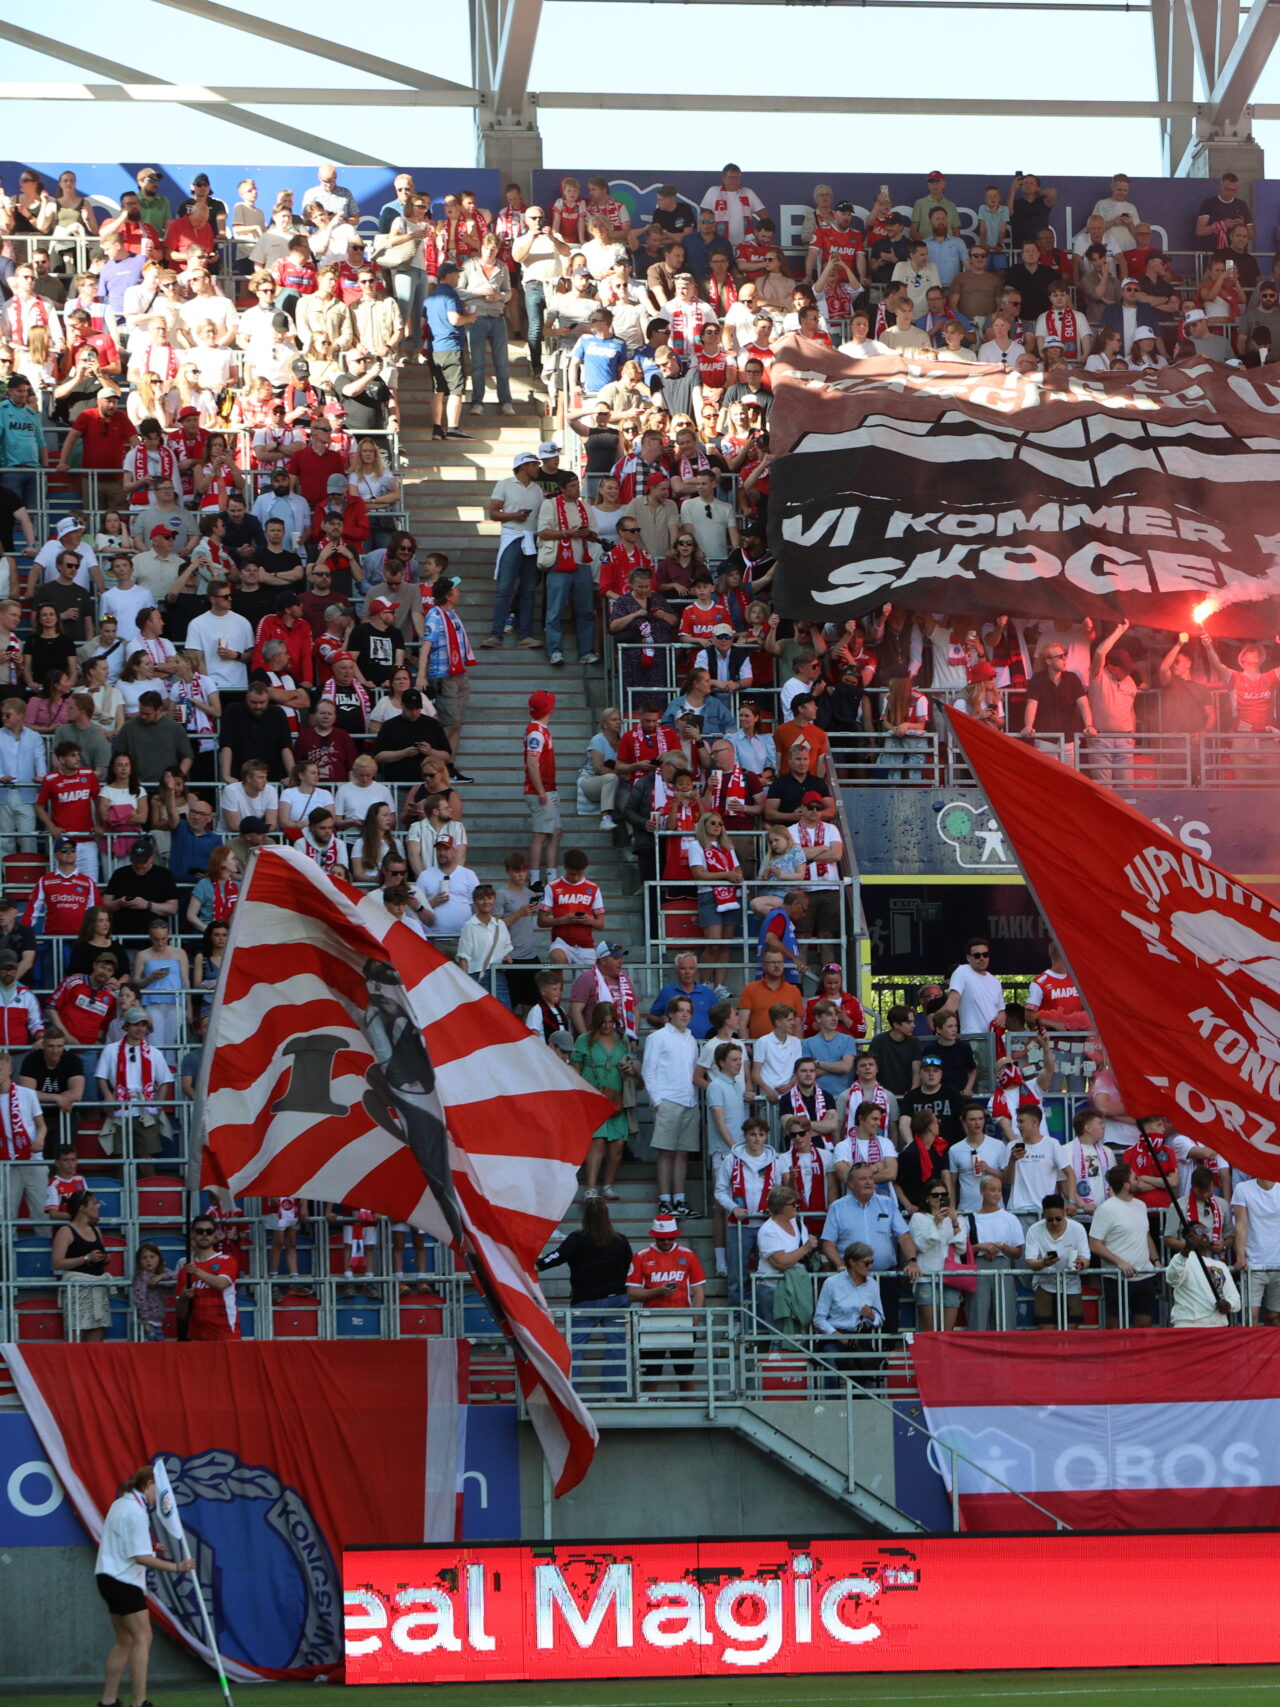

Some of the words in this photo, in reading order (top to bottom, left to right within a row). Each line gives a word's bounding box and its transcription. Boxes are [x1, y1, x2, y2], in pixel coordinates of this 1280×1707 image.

[830, 246, 856, 256] MAPEI
[699, 362, 727, 372] MAPEI
[782, 506, 858, 548] VI
[884, 502, 1233, 553] KOMMER
[558, 893, 592, 905] MAPEI
[987, 914, 1035, 939] TAKK
[651, 1271, 685, 1283] MAPEI
[1054, 1442, 1262, 1499] OBOS
